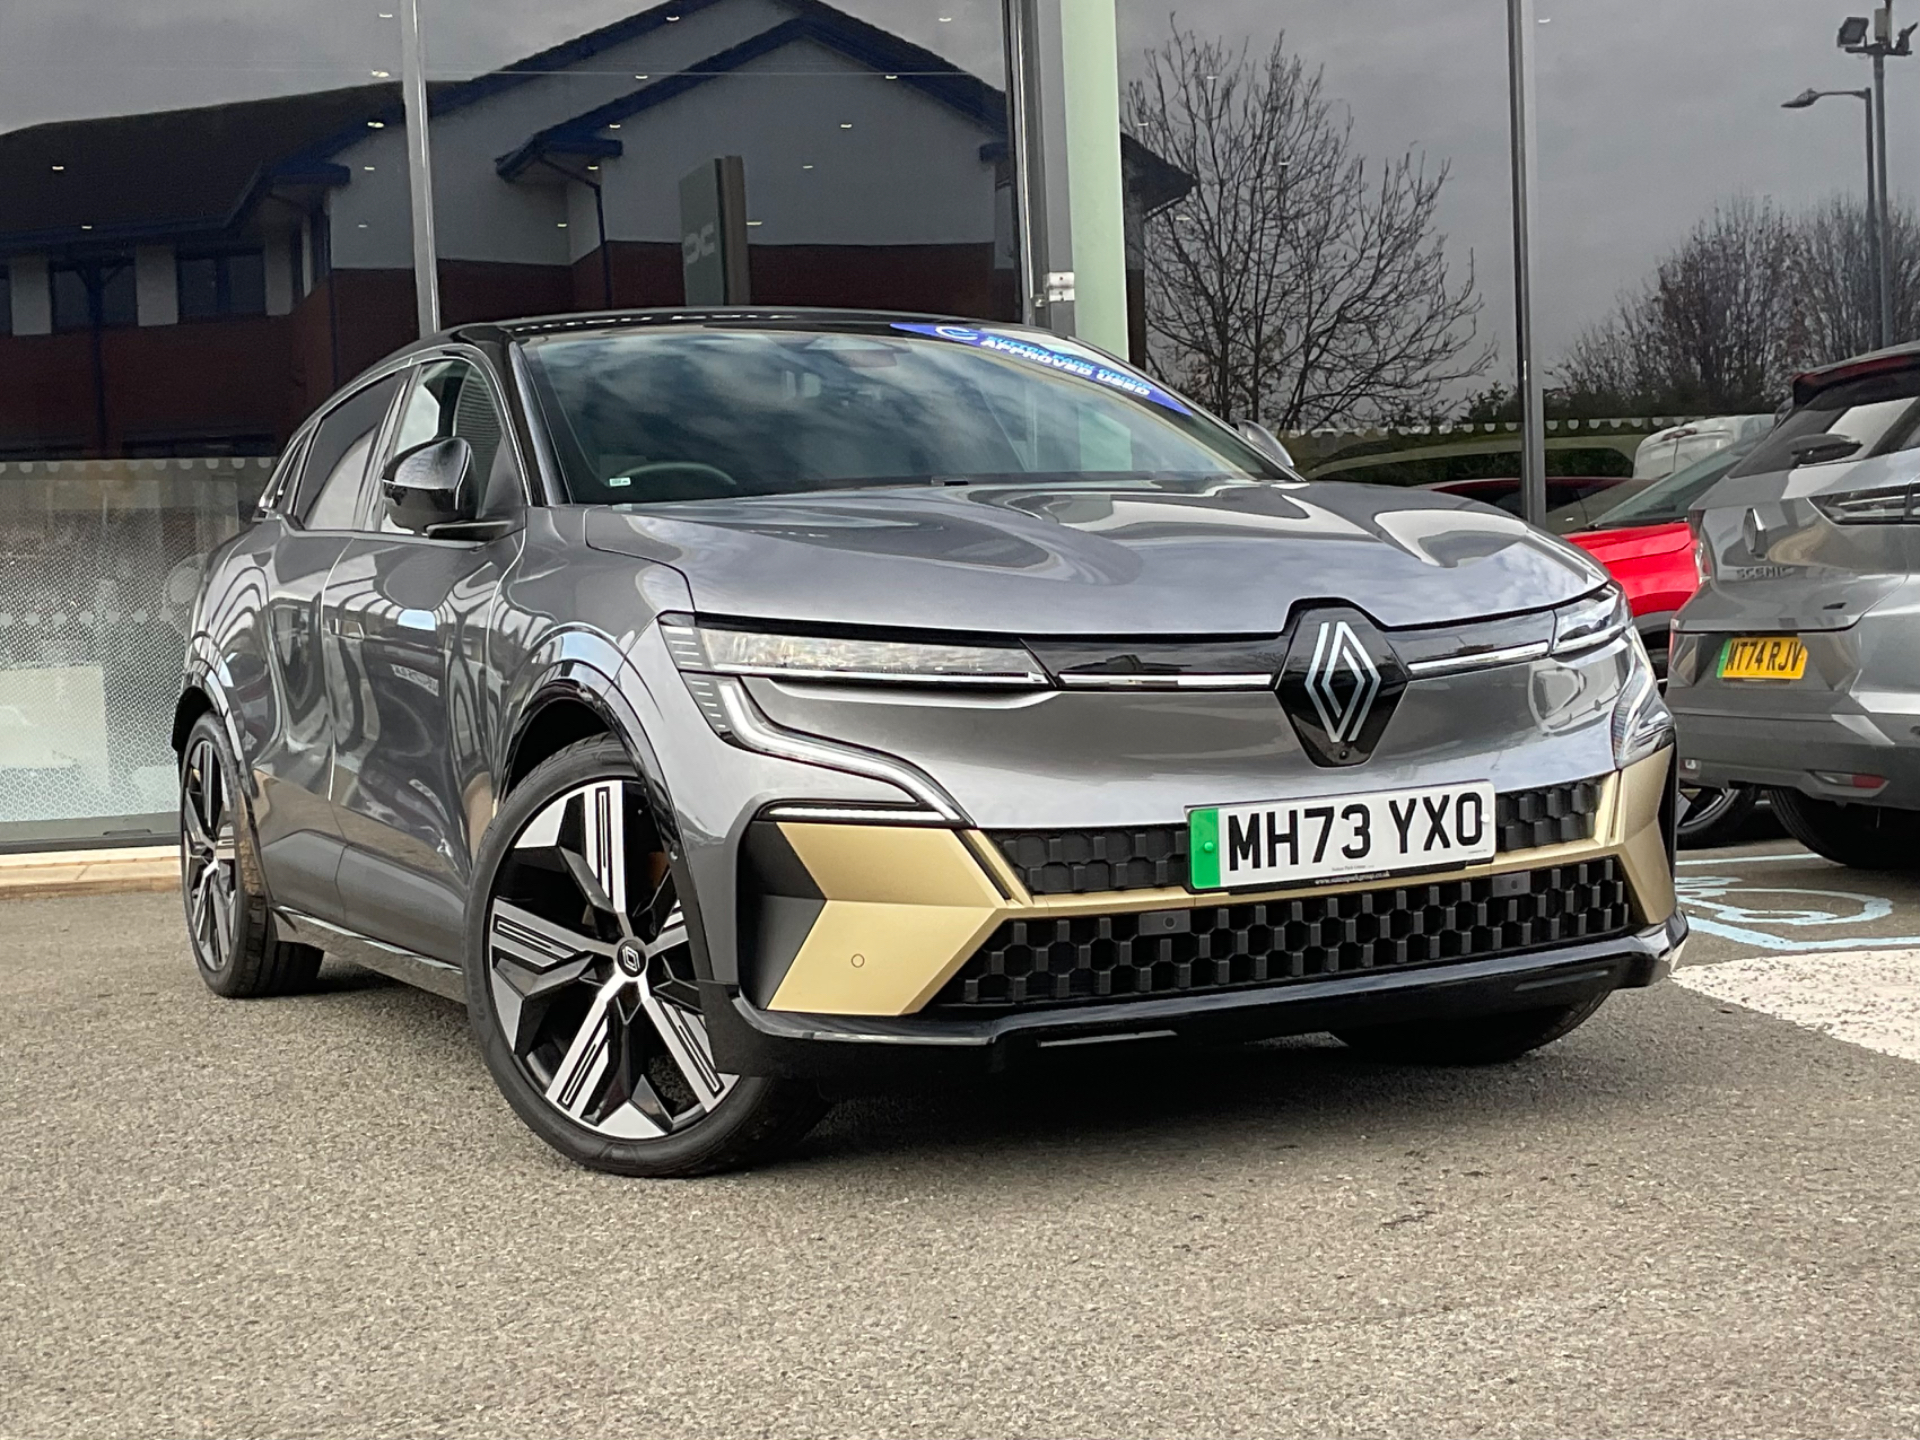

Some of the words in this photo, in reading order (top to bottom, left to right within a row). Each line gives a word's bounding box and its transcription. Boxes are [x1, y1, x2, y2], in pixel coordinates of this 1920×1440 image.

[981, 340, 1092, 375] APPROVED
[1096, 373, 1150, 396] USED
[1767, 641, 1801, 671] RJV
[1228, 804, 1371, 871] MH73
[1388, 792, 1482, 854] YXO
